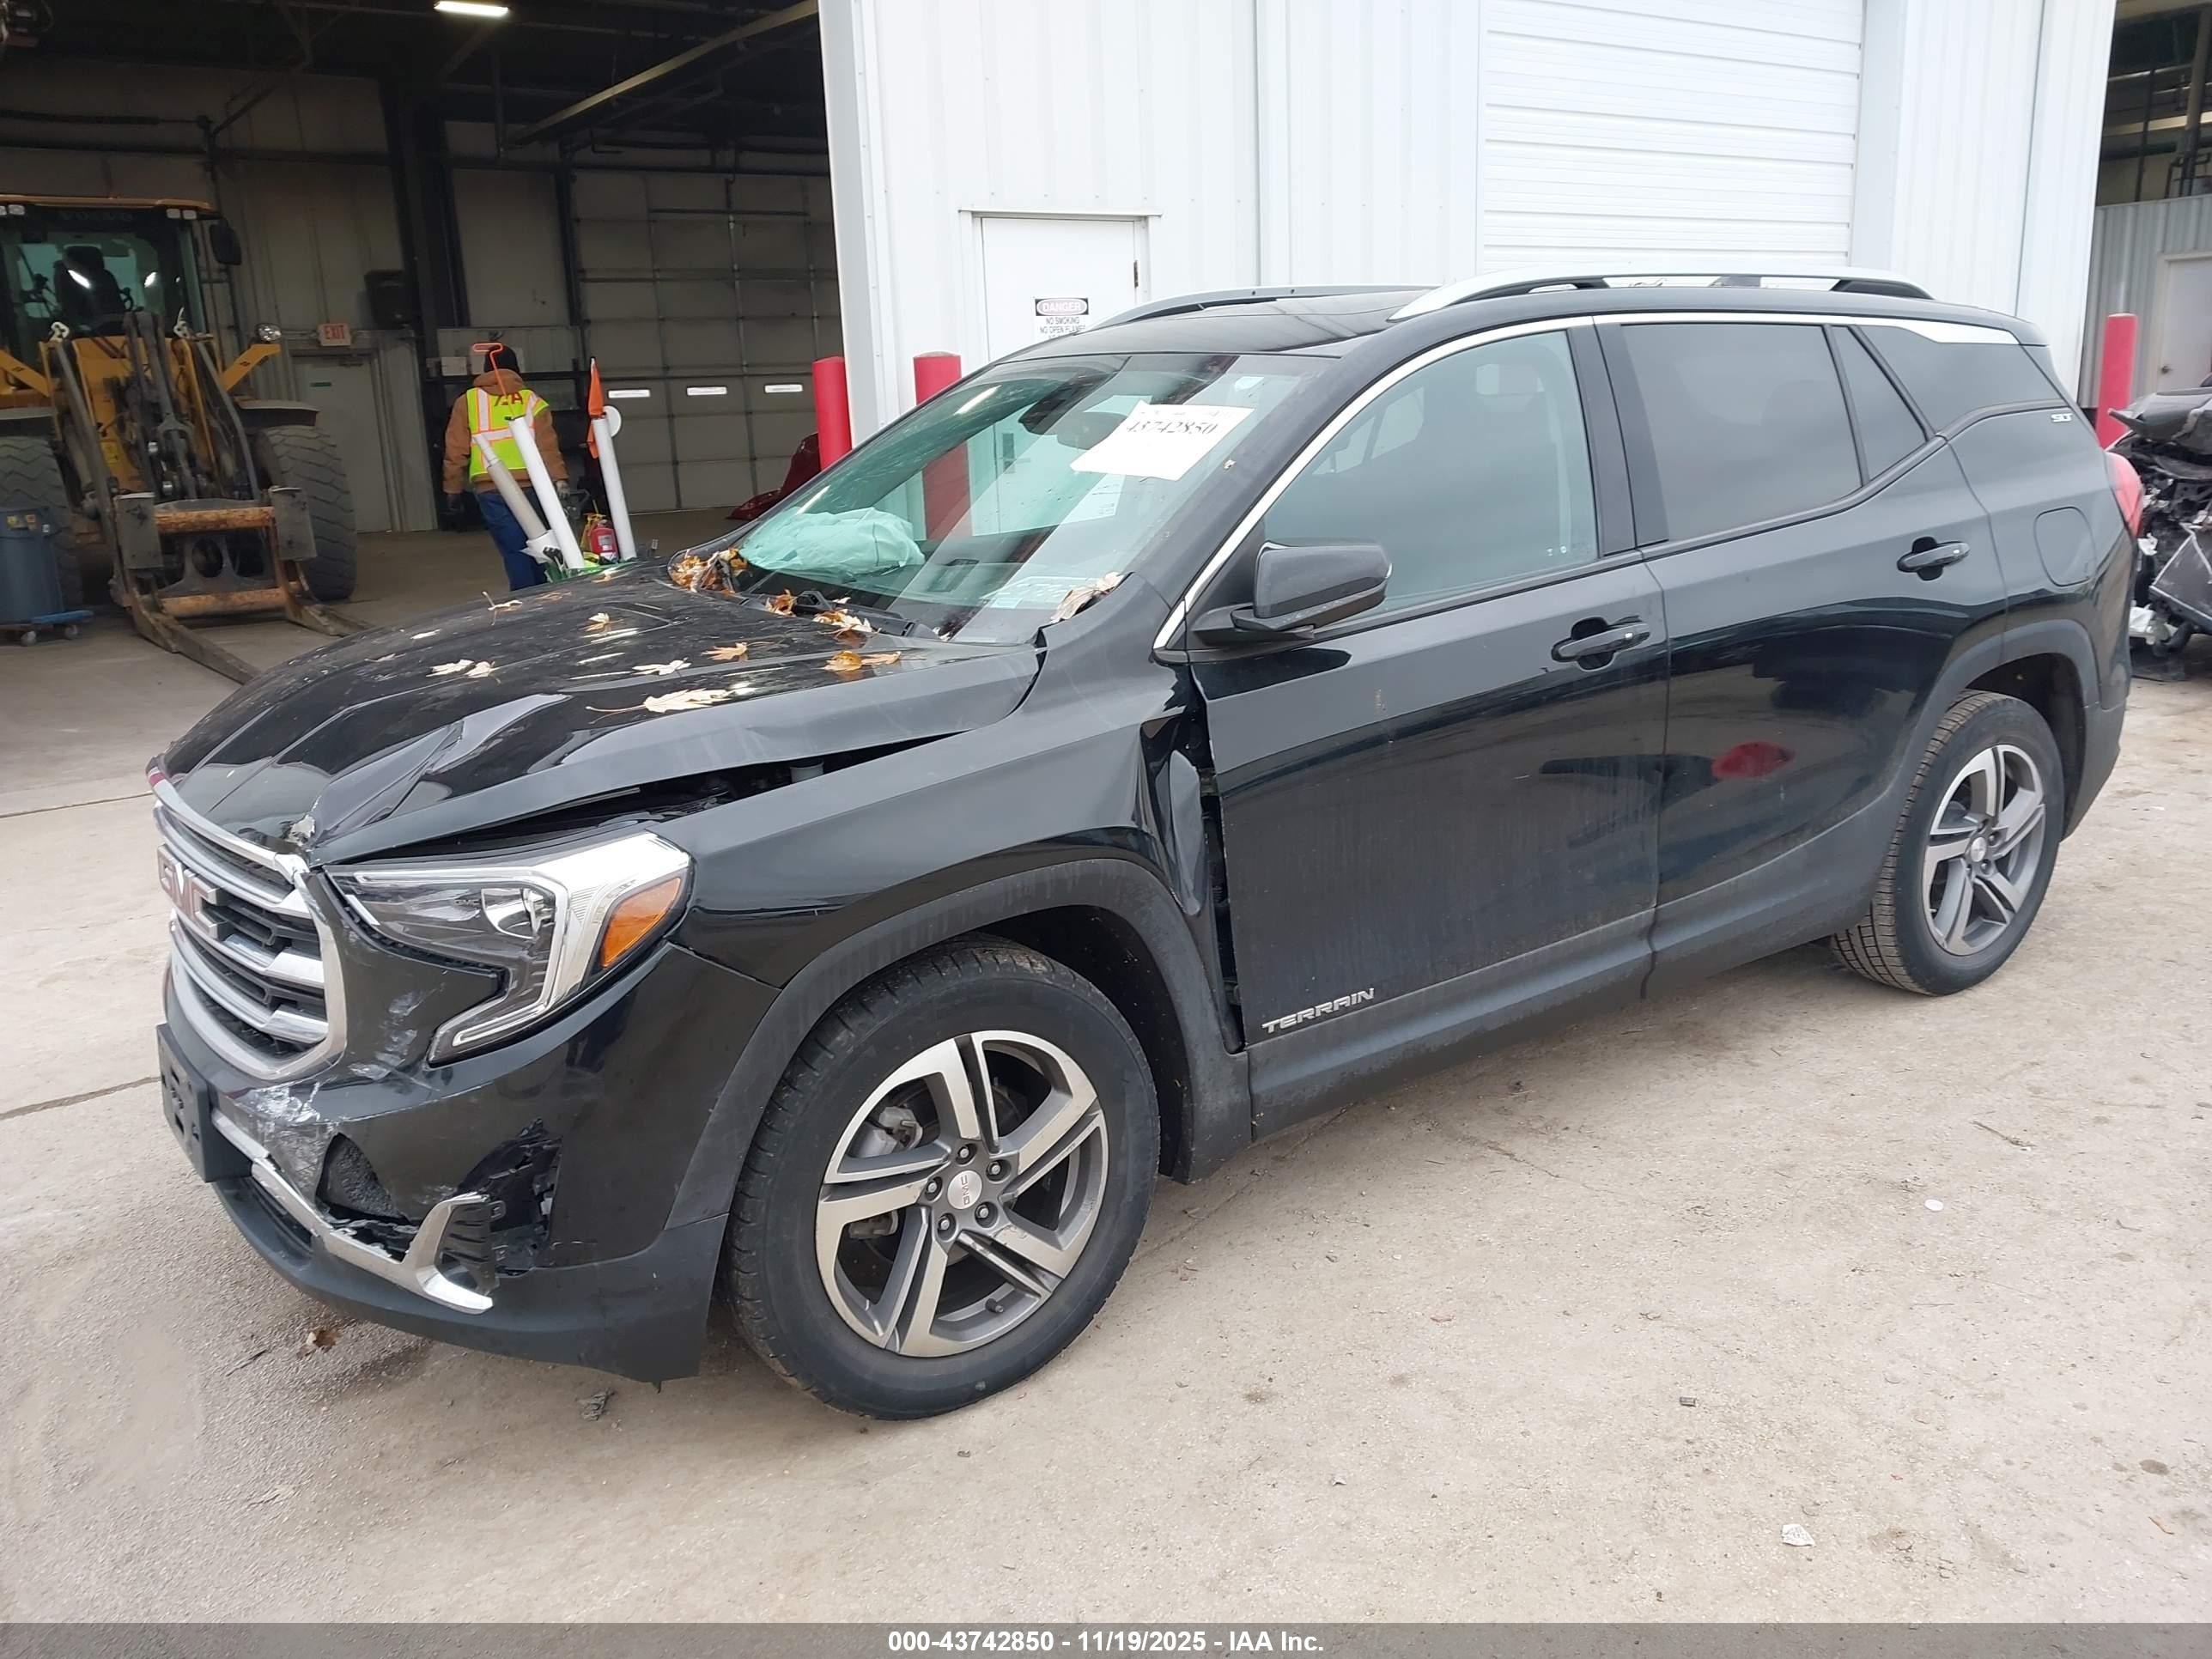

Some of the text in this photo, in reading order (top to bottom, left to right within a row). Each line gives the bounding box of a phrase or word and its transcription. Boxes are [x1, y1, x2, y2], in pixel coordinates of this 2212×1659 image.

[1042, 301, 1082, 312] DANGER
[1055, 316, 1080, 325] SMOKING
[324, 325, 345, 340] EXIT
[2051, 413, 2073, 422] SLT
[1126, 420, 1219, 434] 43742850
[157, 842, 221, 942] GMC
[1261, 988, 1375, 1034] TERRAIN
[961, 1175, 970, 1206] GMC
